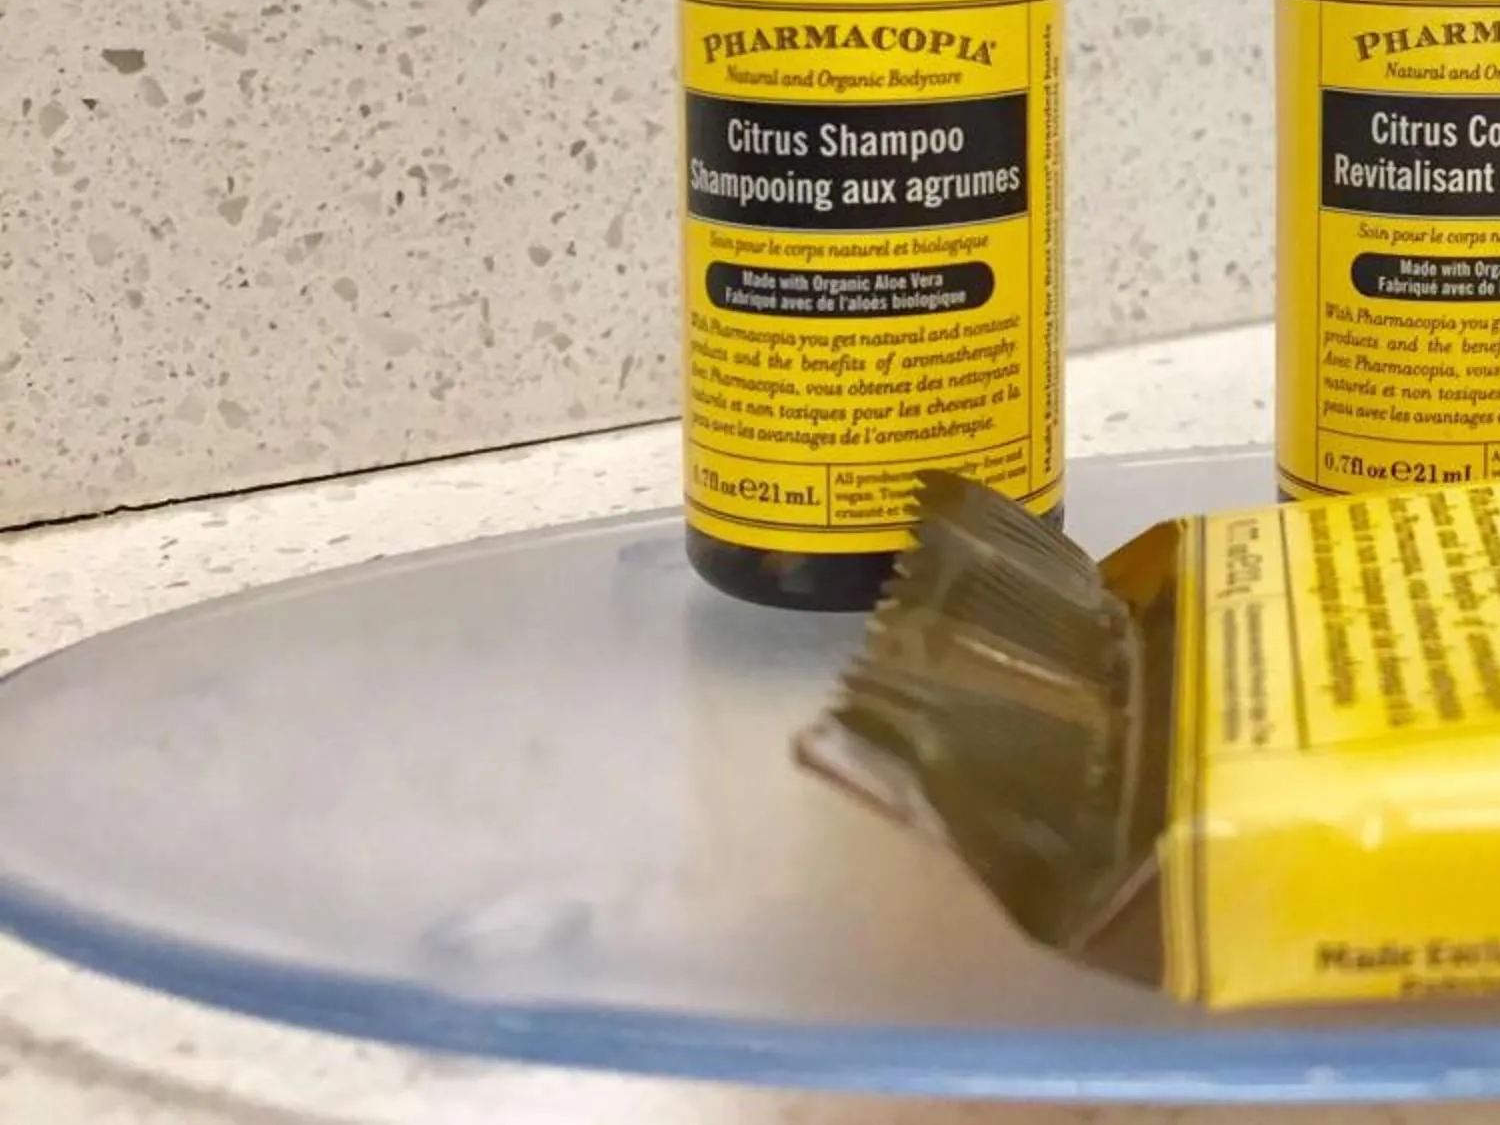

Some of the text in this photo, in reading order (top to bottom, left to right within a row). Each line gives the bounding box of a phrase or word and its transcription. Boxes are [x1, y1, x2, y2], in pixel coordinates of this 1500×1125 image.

[703, 24, 995, 66] PHARMACOPIA
[783, 69, 814, 88] and
[819, 69, 885, 94] Organic
[888, 69, 963, 93] Bodycare
[1385, 62, 1446, 79] Natural
[1449, 62, 1479, 81] and
[728, 118, 965, 161] Citrus Shampoo
[1370, 111, 1457, 147] Citrus
[691, 158, 1021, 212] Shampooing aux agrumes
[1333, 152, 1496, 194] Revitalisant
[743, 271, 943, 296] Made with Organic Aloe Vera
[1399, 259, 1437, 276] Made
[1441, 261, 1471, 277] with
